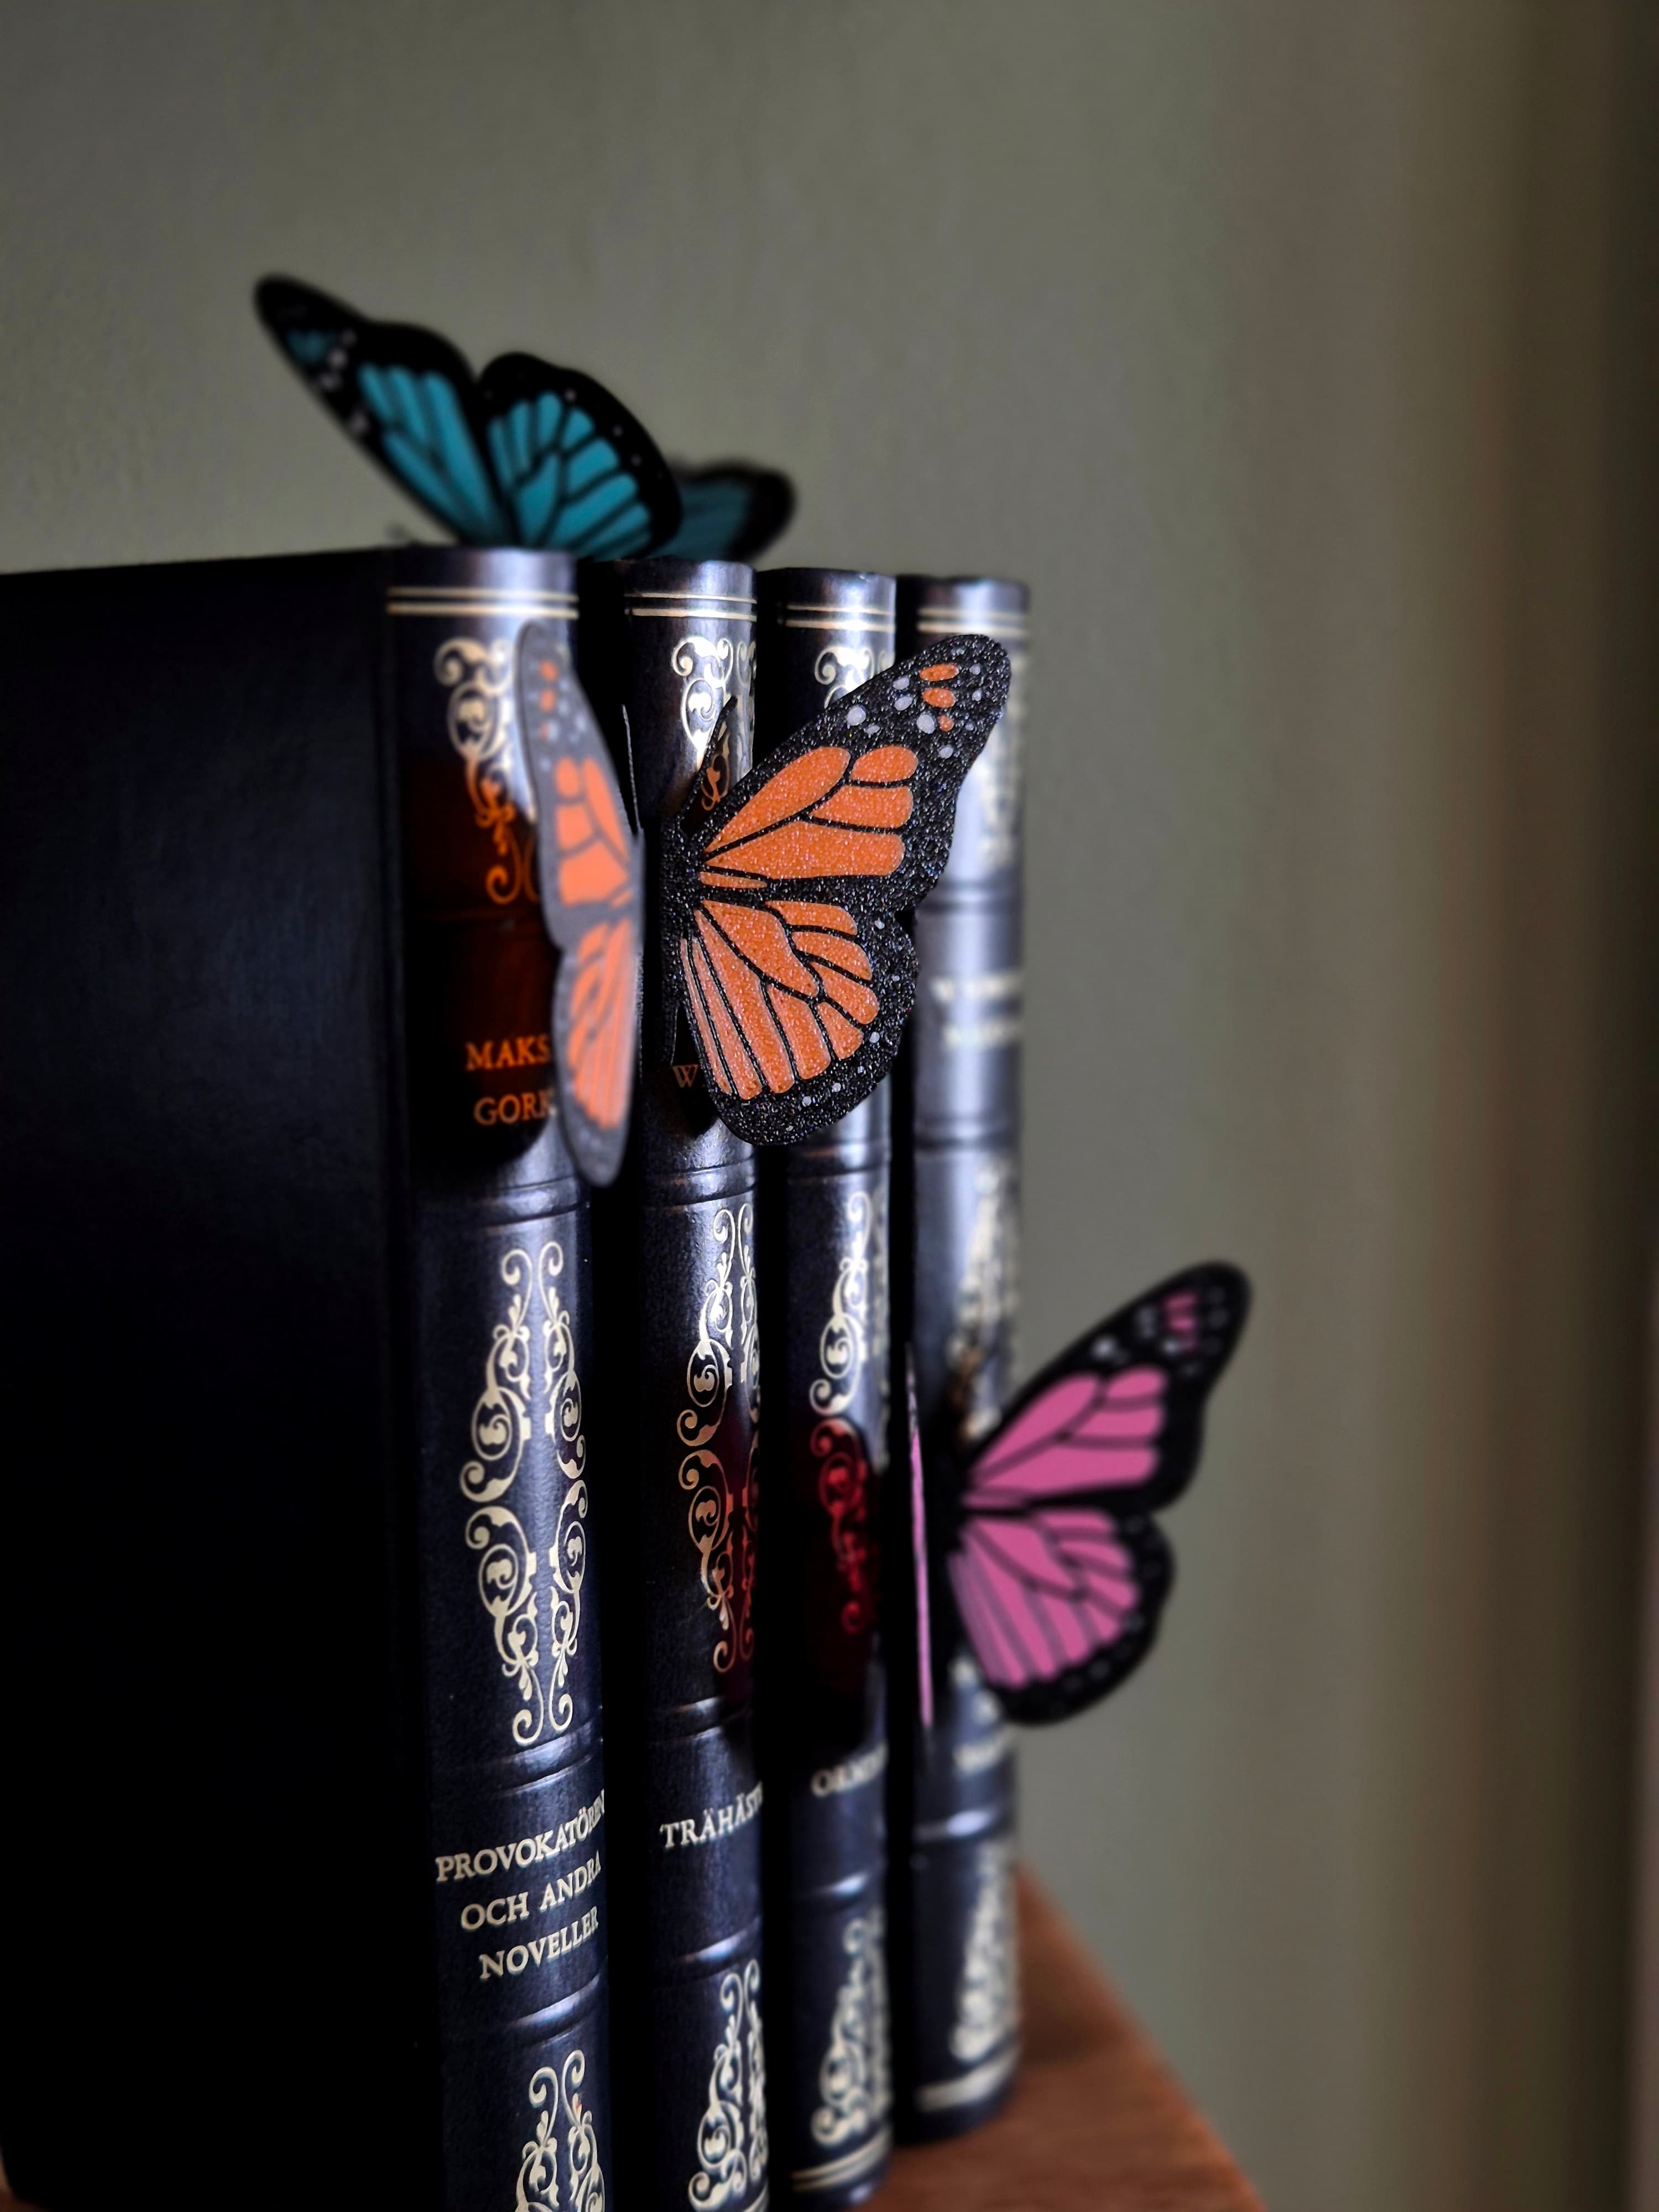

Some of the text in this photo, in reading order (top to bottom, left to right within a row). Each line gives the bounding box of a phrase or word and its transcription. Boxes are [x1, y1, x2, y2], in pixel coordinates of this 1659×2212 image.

[461, 1850, 601, 1931] OCH ANDRA
[479, 1906, 599, 1980] NOVELLER
